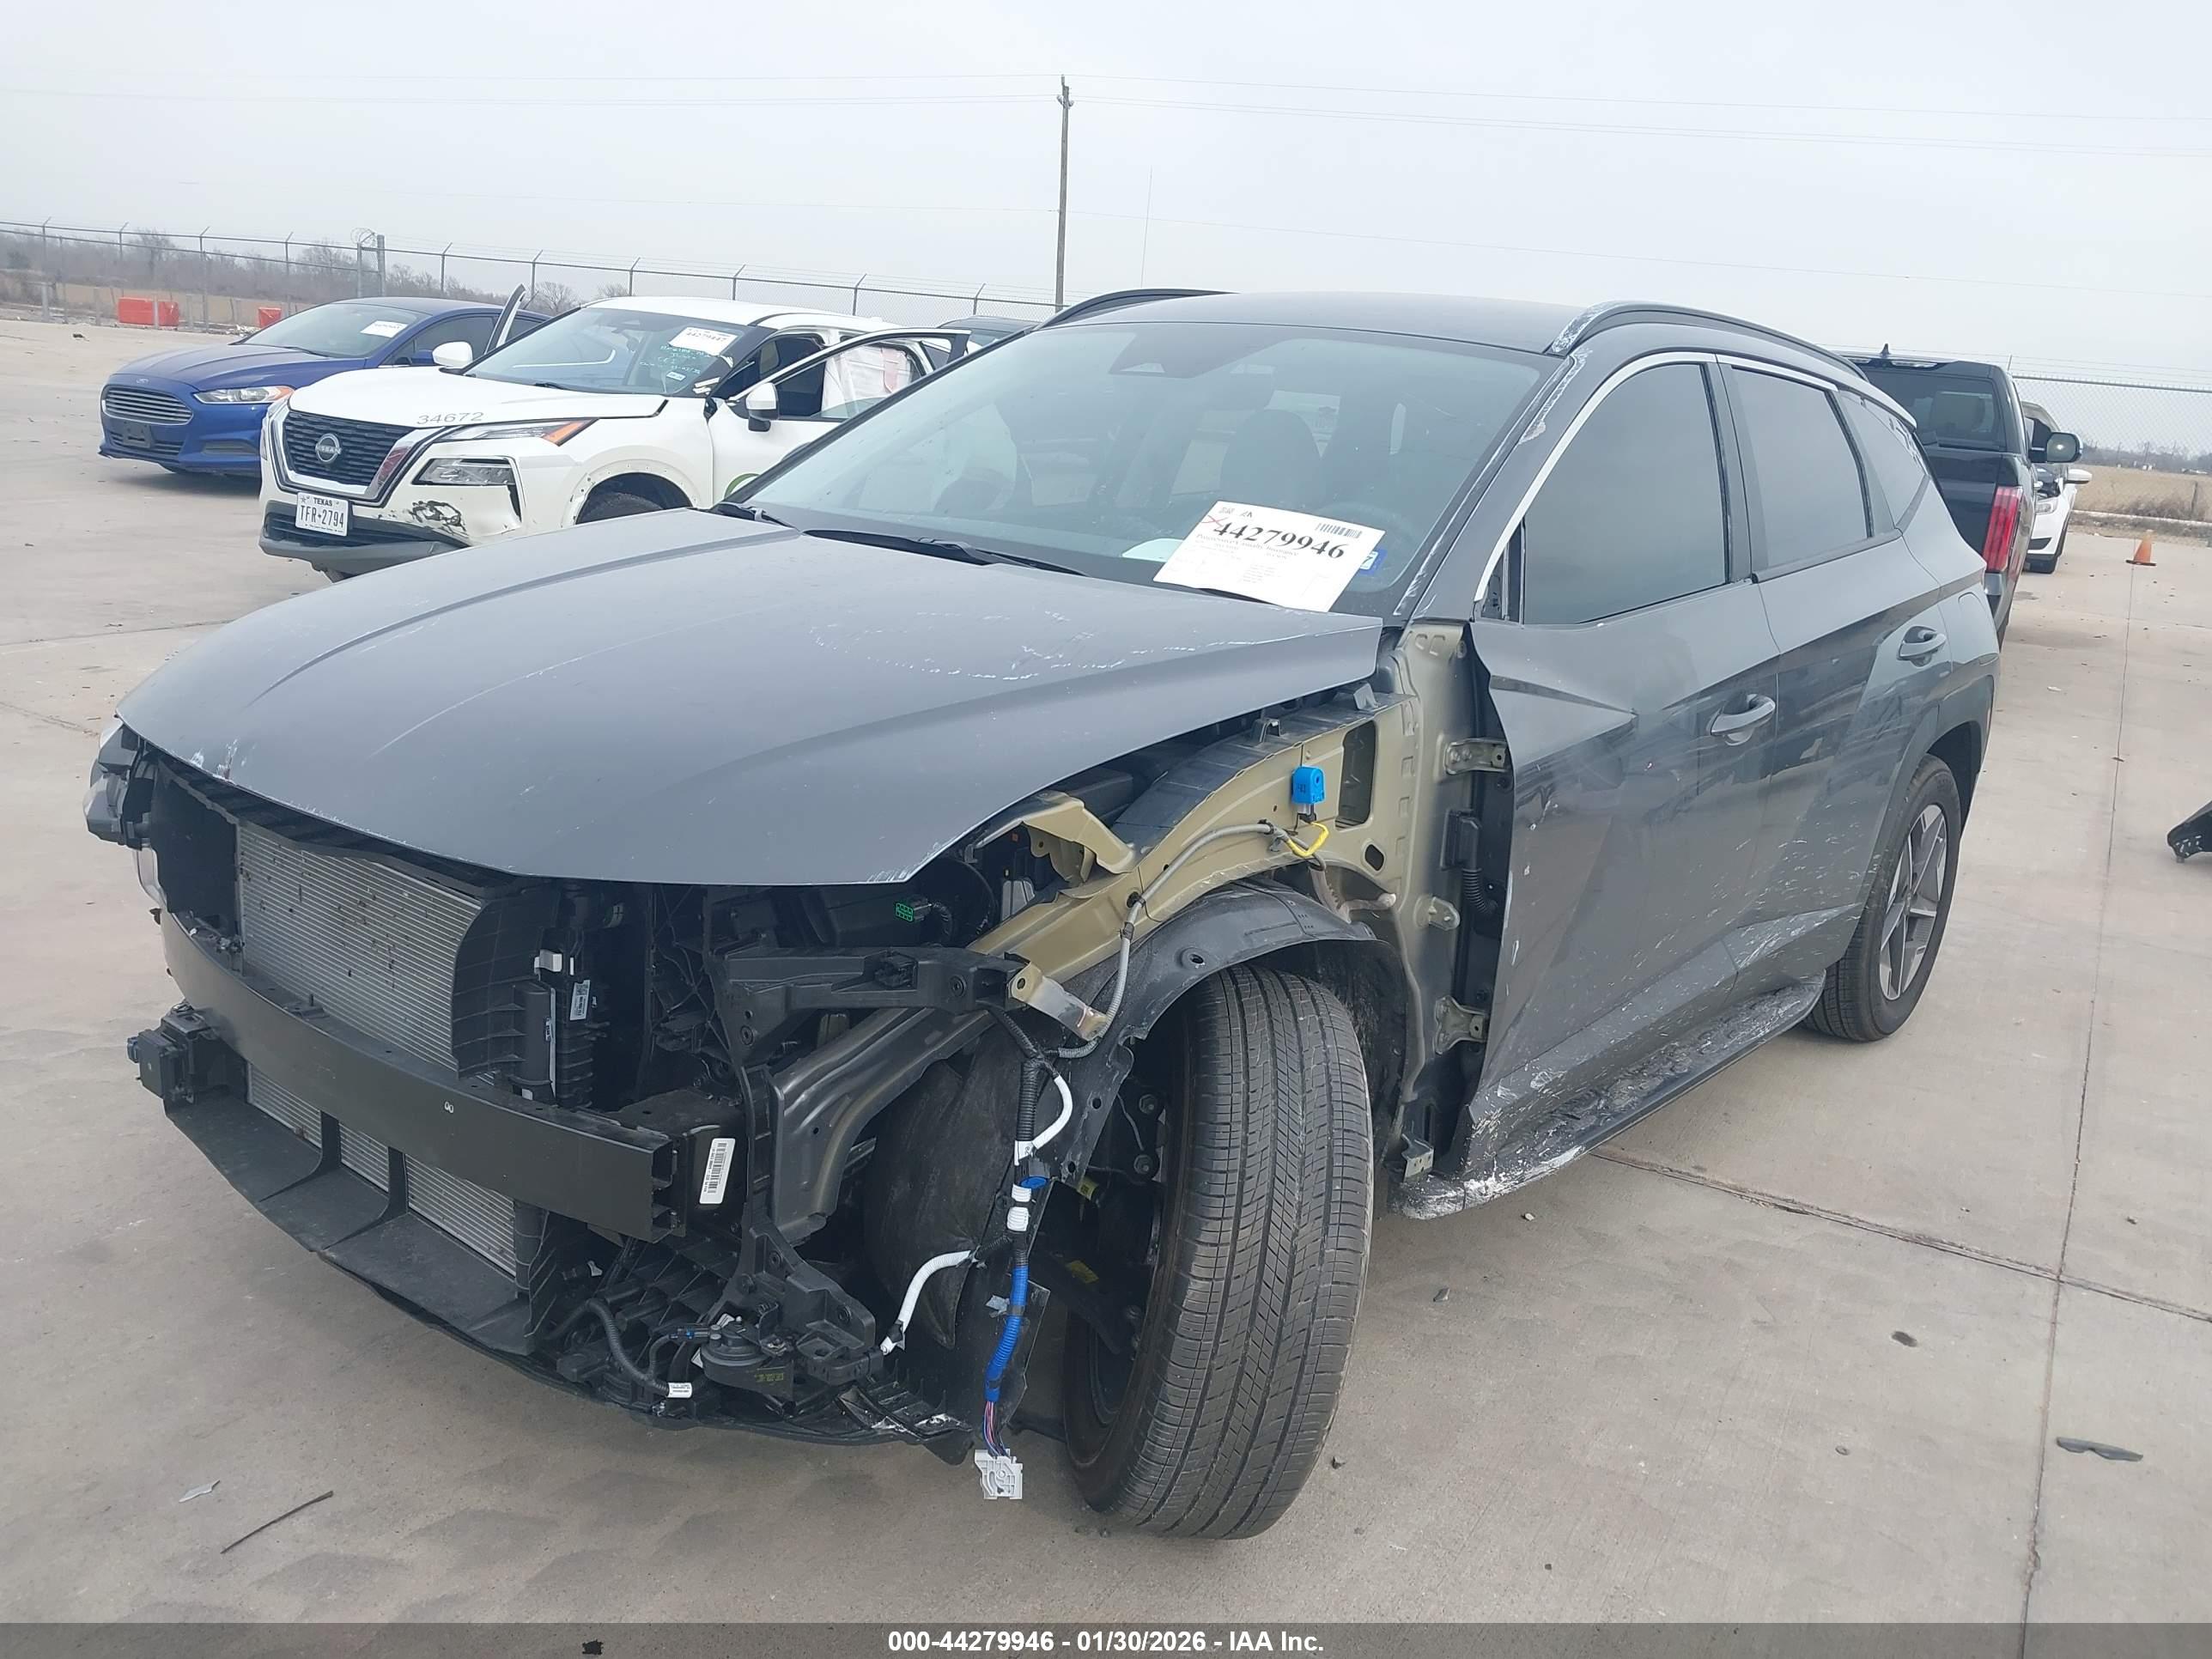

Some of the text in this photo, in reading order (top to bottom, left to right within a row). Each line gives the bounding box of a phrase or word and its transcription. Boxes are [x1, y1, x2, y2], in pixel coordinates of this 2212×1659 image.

[416, 411, 484, 425] 34672
[313, 496, 333, 507] TEXAS
[1213, 522, 1349, 559] 44279946
